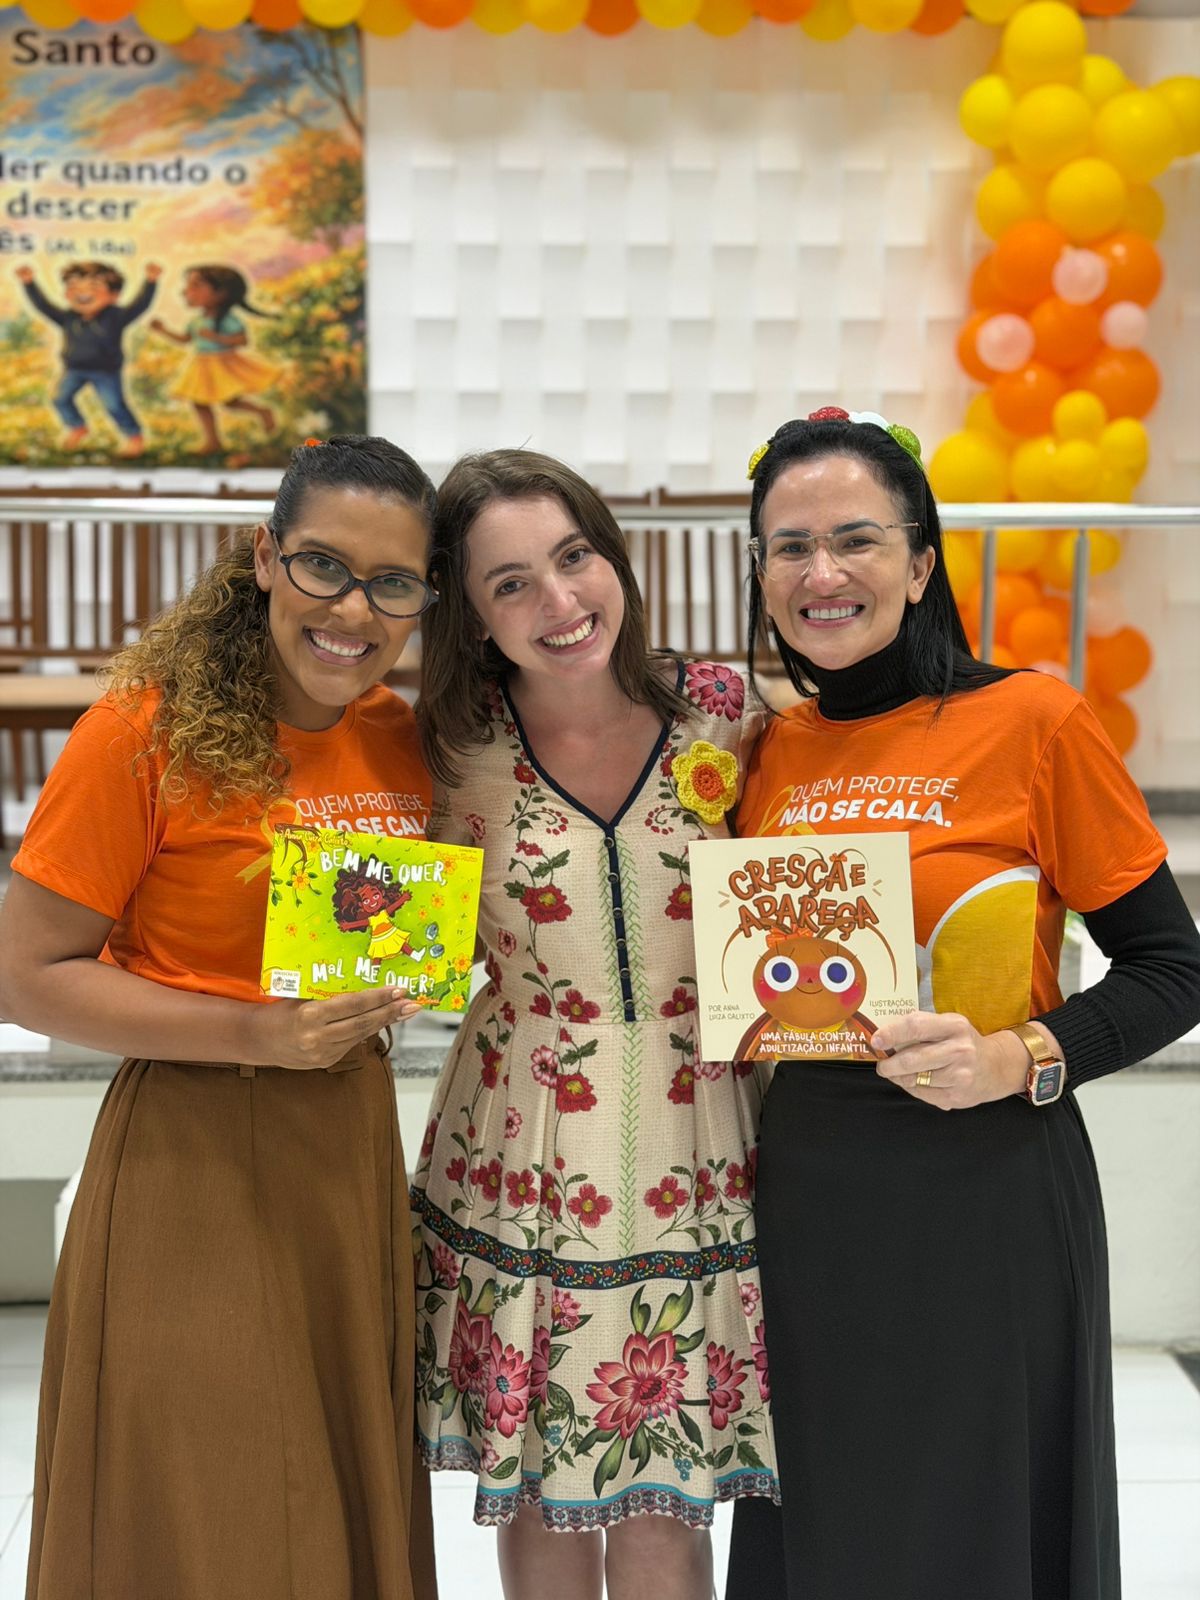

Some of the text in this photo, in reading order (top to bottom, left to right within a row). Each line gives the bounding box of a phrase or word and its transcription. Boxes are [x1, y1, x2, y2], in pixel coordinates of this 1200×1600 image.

[13, 30, 156, 67] Santo
[62, 157, 209, 188] quando
[224, 162, 247, 185] o
[7, 191, 136, 219] descer
[790, 776, 960, 802] QUEM PROTEGE,
[295, 792, 431, 817] QUEM PROTEGE,
[778, 798, 953, 828] NÃO SE CALA.
[355, 816, 387, 837] SE
[319, 848, 447, 887] BEM ME QUER,
[728, 853, 866, 901] CRESÇA E
[738, 893, 880, 941] APAREÇA
[355, 956, 381, 983] ME
[385, 970, 435, 995] QUER?
[708, 1004, 722, 1012] POR
[760, 1029, 867, 1042] UMA FÁBULA CONTRA A
[760, 1041, 870, 1054] ADULTIZAÇÃO INFANTIL
